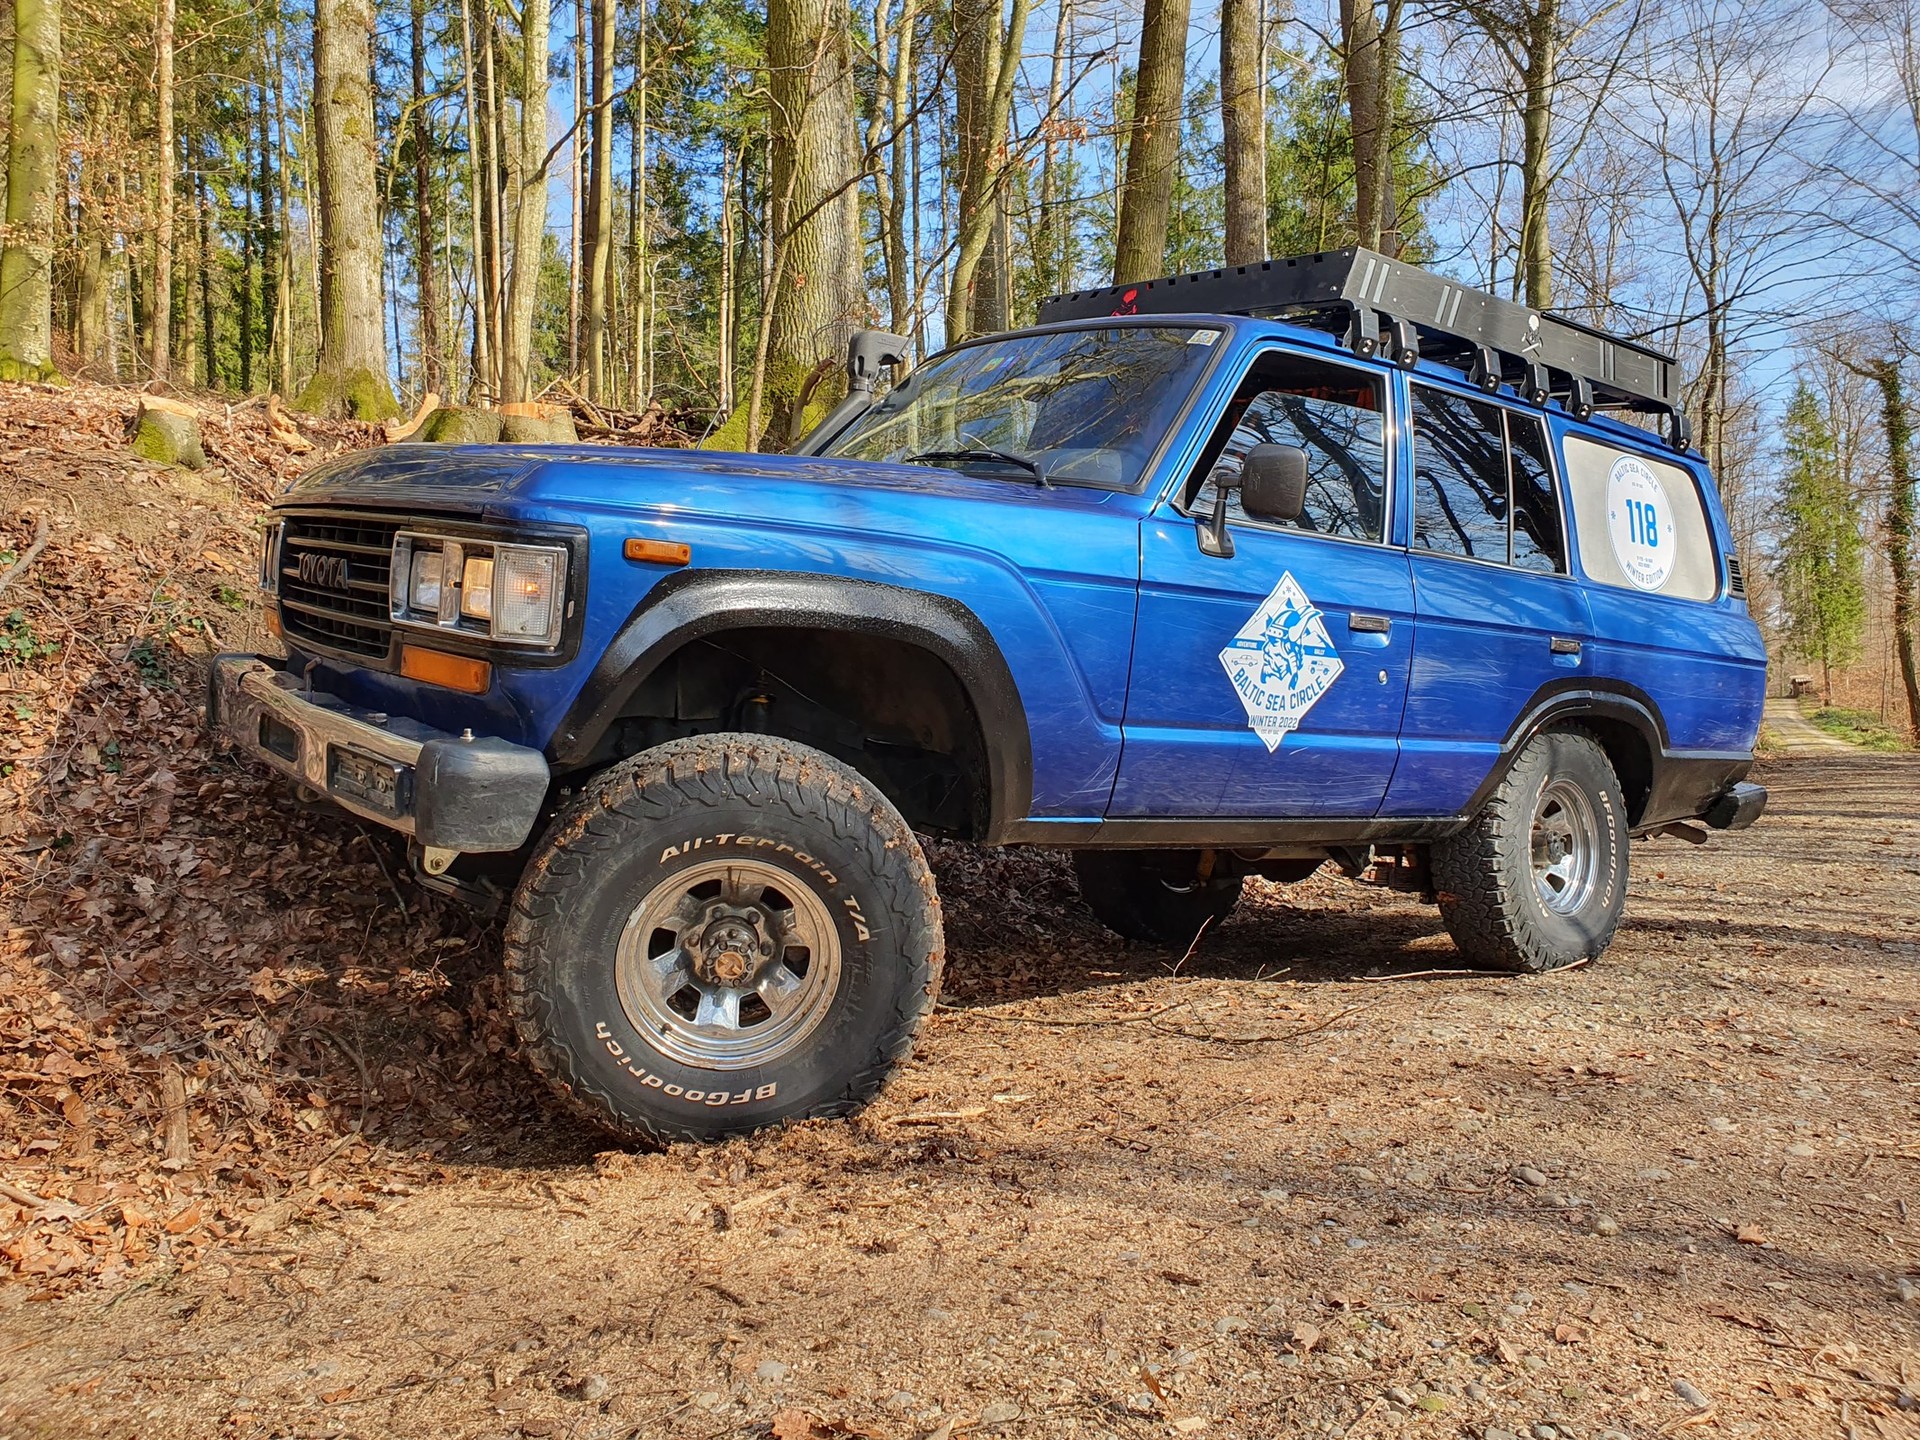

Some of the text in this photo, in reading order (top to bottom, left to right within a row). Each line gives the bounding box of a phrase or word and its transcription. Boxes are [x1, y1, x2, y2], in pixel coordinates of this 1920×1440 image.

[1629, 463, 1639, 475] SEA
[1640, 467, 1658, 493] CIRCLE
[1626, 499, 1658, 547] 118
[299, 552, 348, 590] TOYOTA
[1626, 560, 1645, 584] WINTER
[1646, 567, 1664, 584] EDITION
[1233, 667, 1325, 711] BALTIC SEA CIRCLE
[1250, 715, 1298, 728] WINTER 2022
[1598, 790, 1617, 908] BFGoodrich
[660, 833, 838, 884] All-Terrain
[844, 895, 870, 941] T/A
[595, 1021, 777, 1106] BFGoodrich
